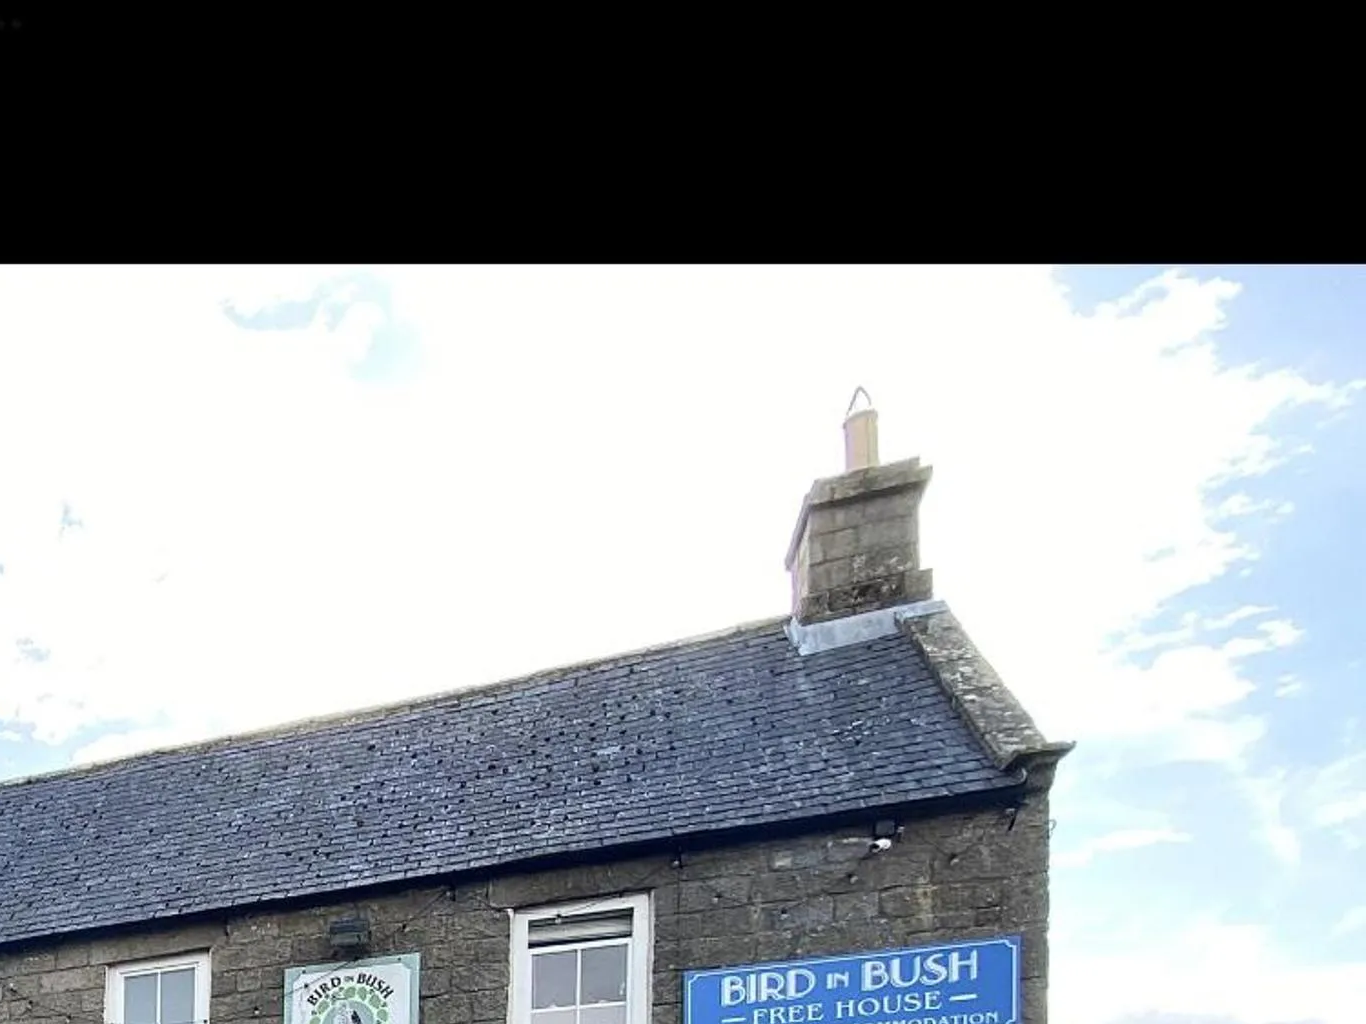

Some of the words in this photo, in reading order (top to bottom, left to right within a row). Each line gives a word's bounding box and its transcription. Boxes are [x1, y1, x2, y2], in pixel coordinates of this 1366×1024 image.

[307, 976, 342, 1006] BIRD
[356, 972, 394, 1000] BUSH
[721, 968, 815, 1007] BIRD
[826, 971, 850, 990] IN
[860, 949, 978, 992] BUSH
[836, 990, 943, 1019] HOUSE
